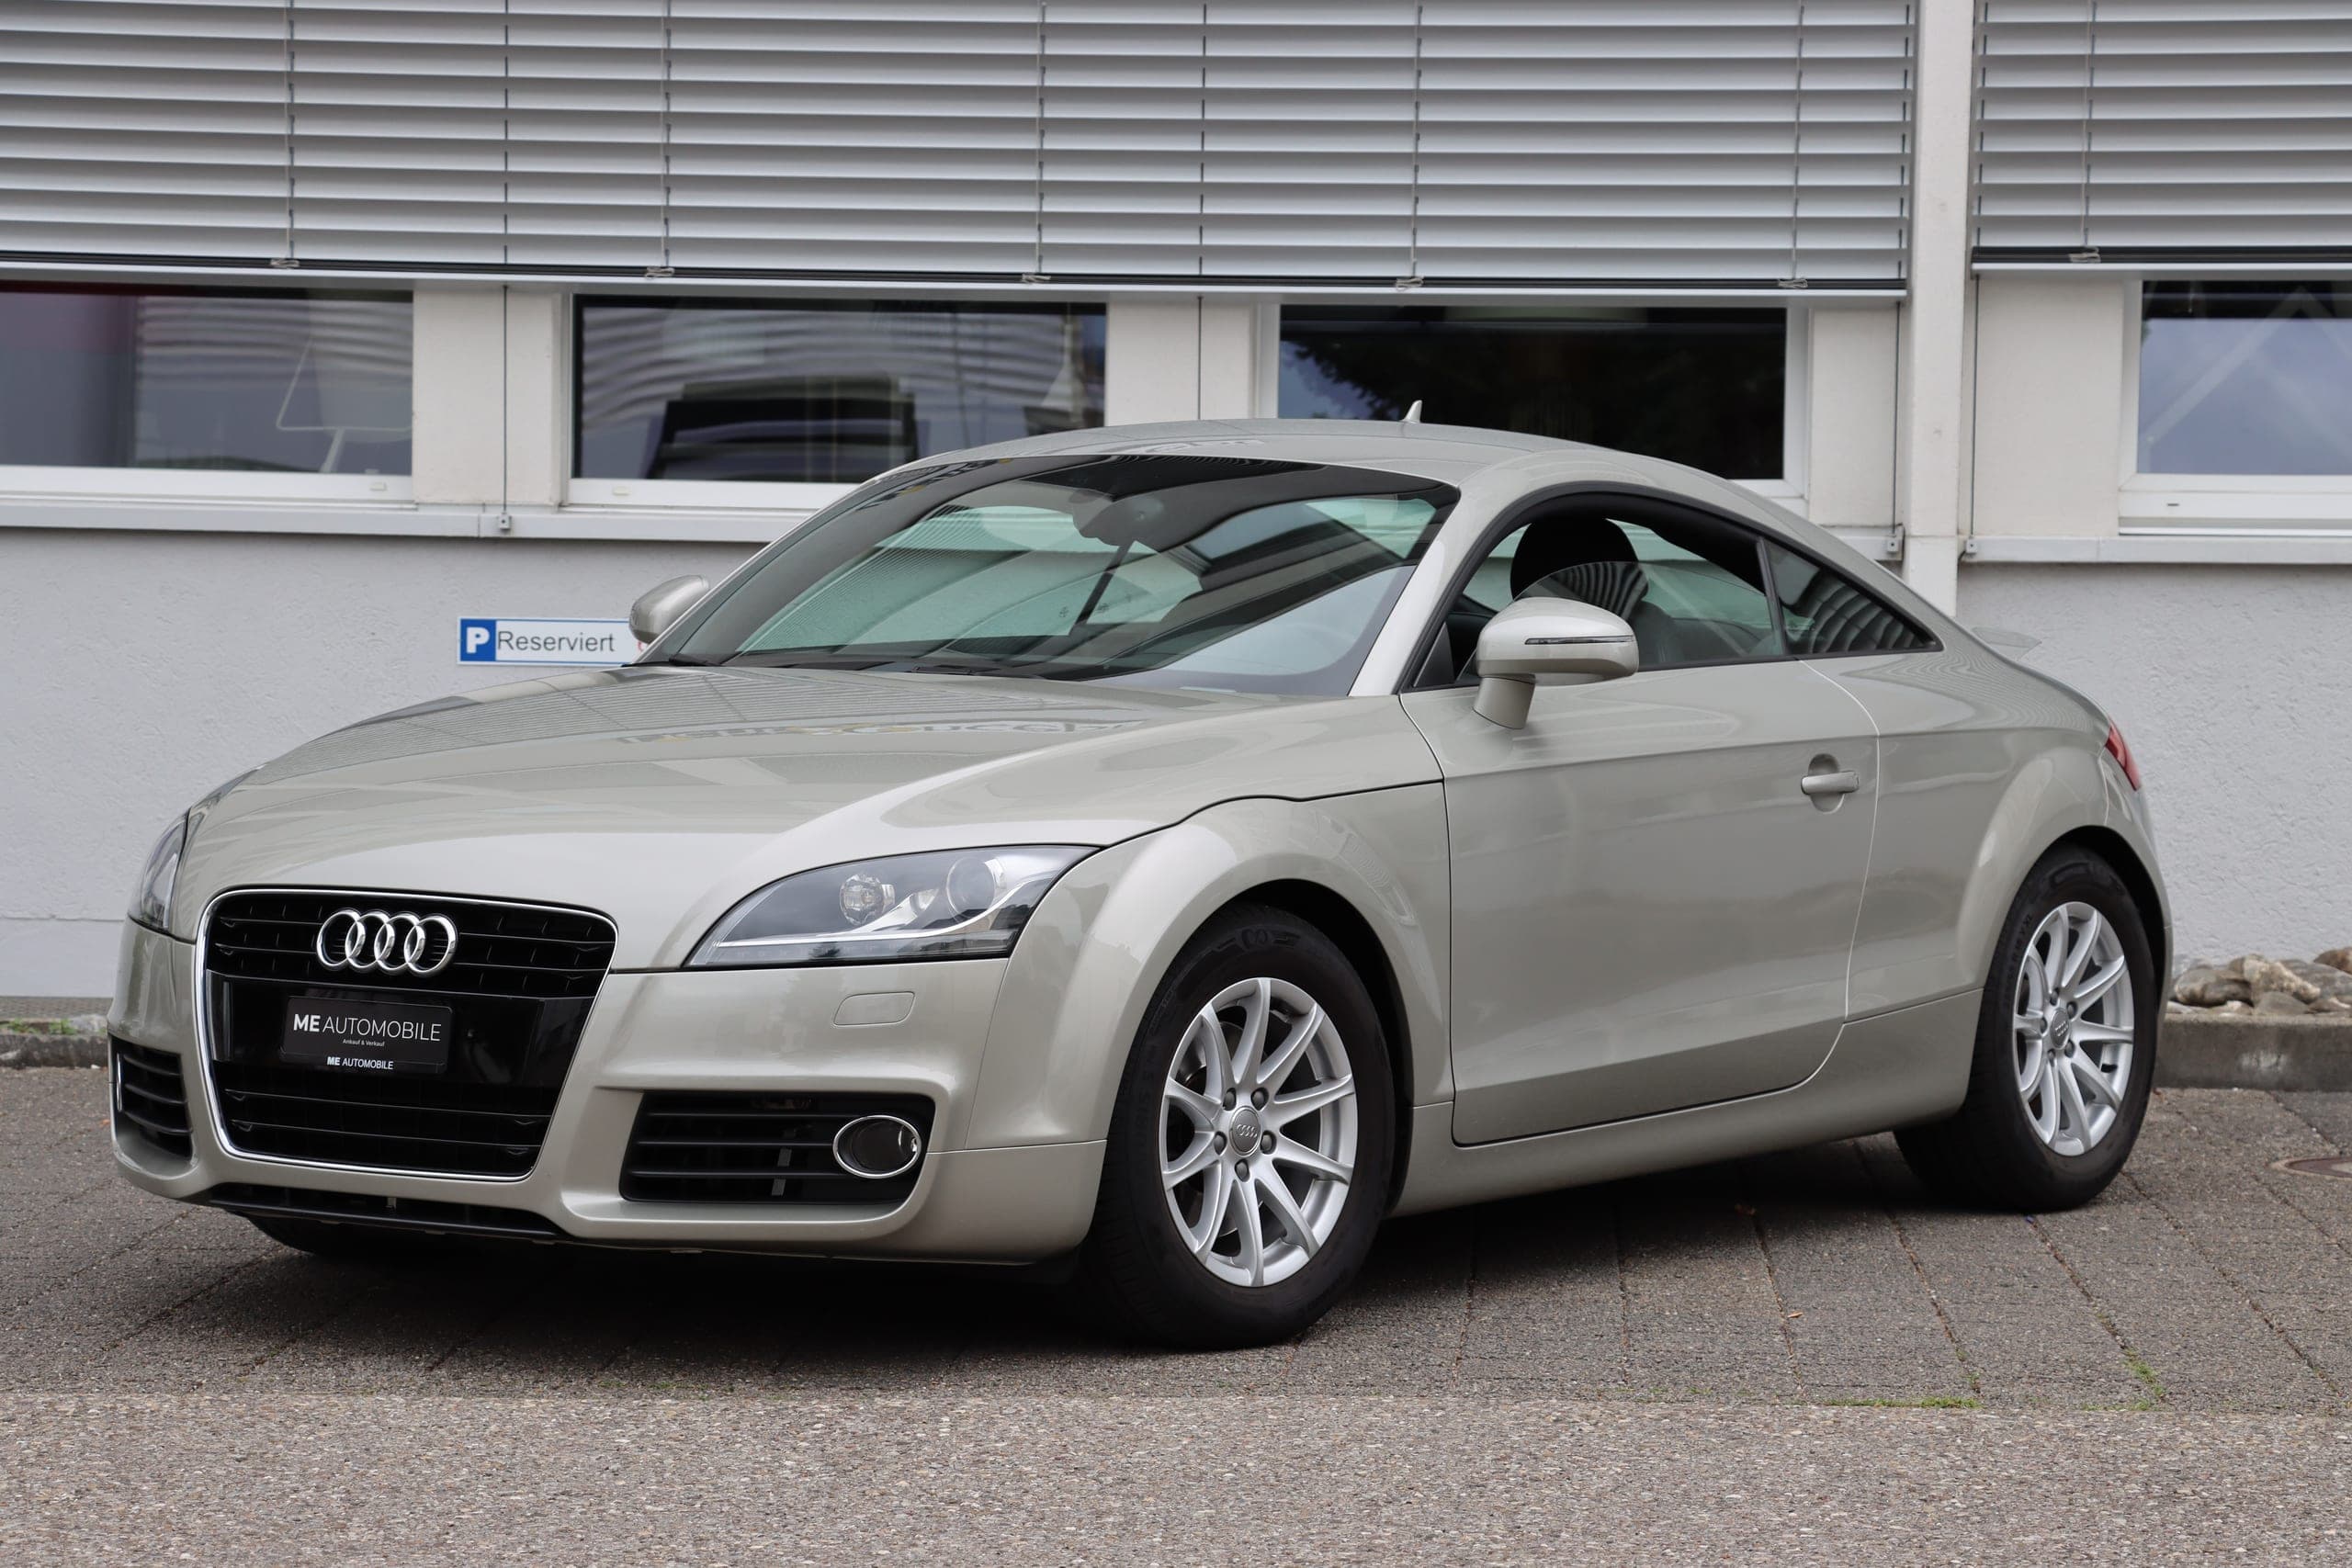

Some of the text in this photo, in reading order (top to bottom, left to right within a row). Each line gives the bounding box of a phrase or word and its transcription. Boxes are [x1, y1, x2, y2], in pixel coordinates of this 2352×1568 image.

[466, 626, 490, 654] P
[497, 630, 615, 652] Reserviert
[293, 1013, 442, 1042] ME AUTOMOBILE
[327, 1056, 394, 1070] ME AUTOMOBILE
